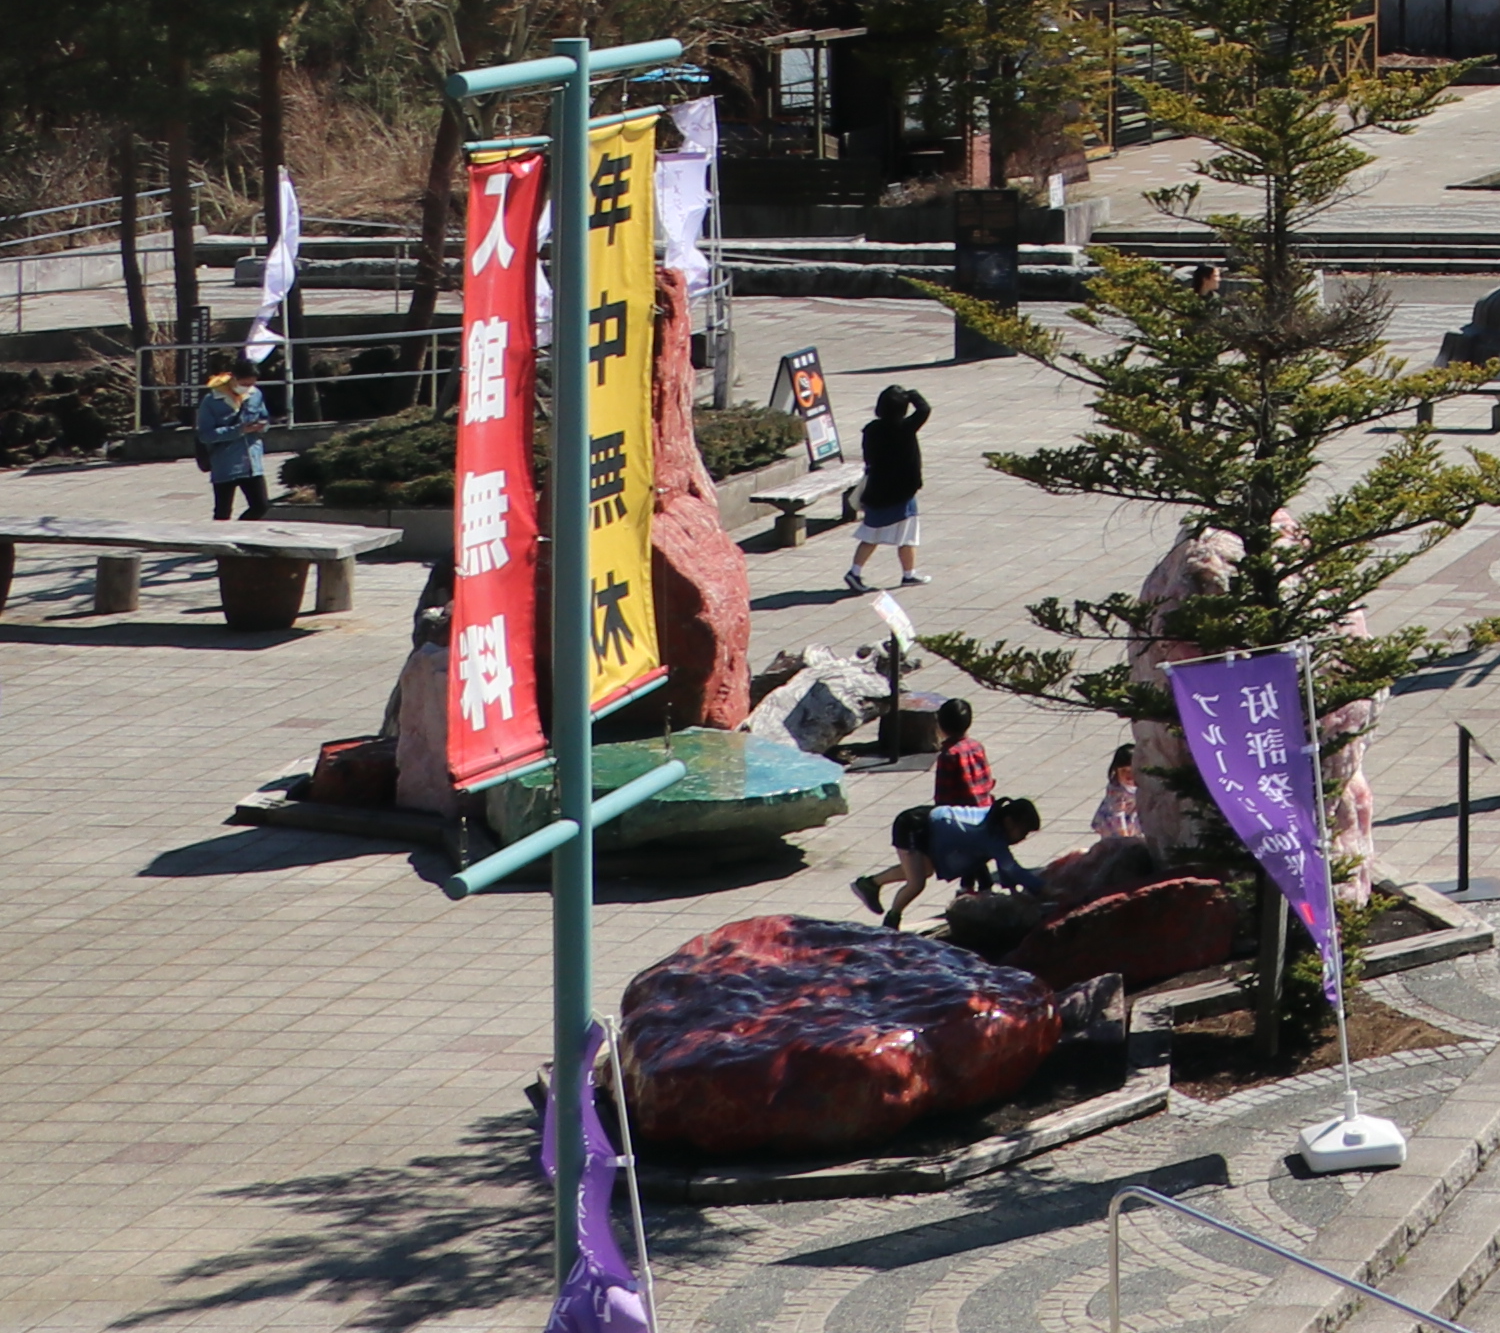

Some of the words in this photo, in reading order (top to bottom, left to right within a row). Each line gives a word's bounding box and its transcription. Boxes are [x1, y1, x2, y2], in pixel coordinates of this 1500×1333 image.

[460, 171, 517, 732] 入館無料
[589, 151, 635, 676] 年中無休
